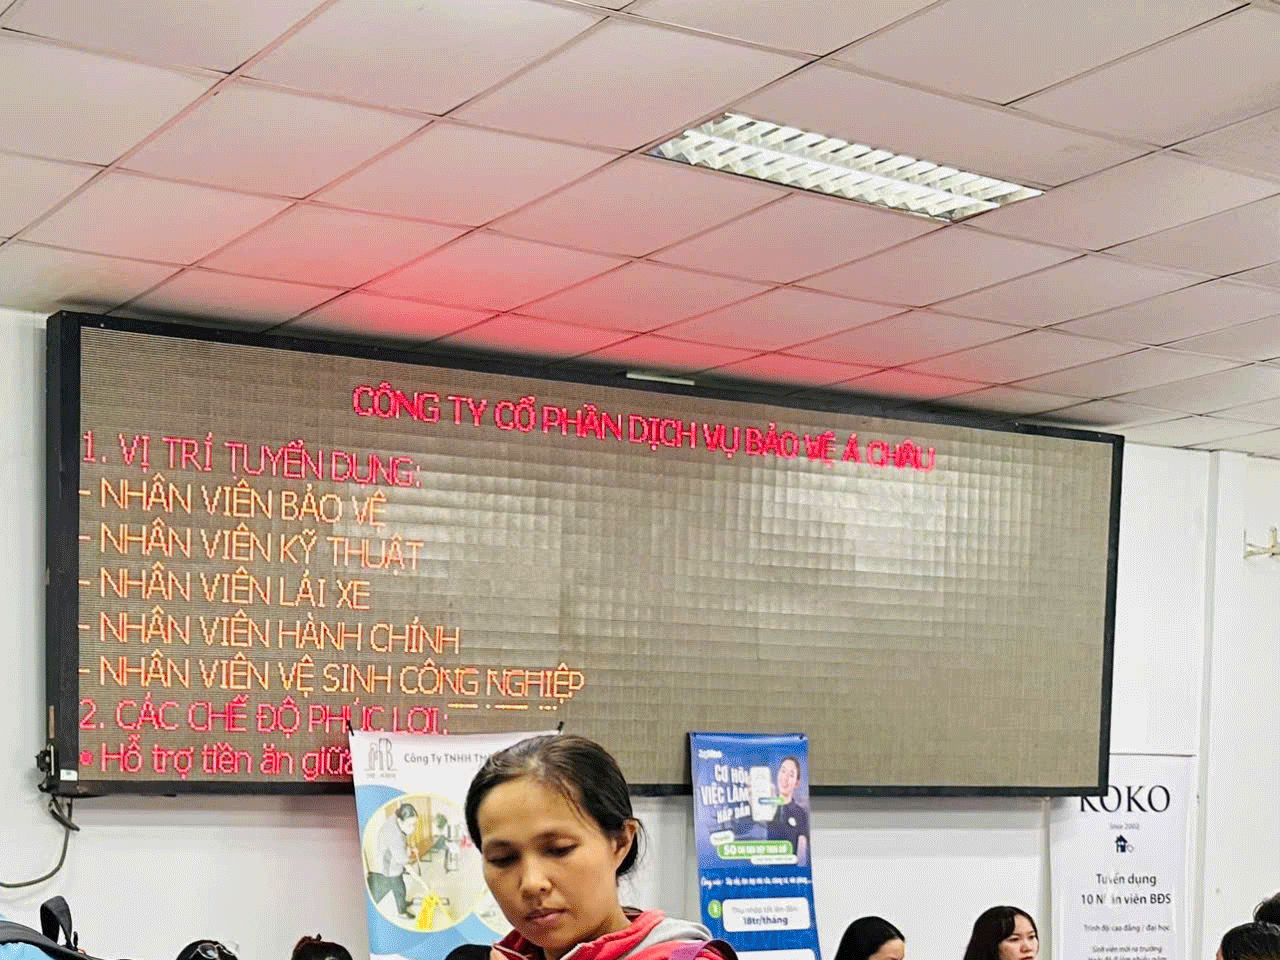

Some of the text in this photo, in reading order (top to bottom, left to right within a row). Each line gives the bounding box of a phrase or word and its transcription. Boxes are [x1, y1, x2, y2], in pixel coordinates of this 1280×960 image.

[352, 381, 937, 474] CÔNG TY CỔ PHẦN DỊCH VỤ BẢO VỆ Á CHÂU
[83, 431, 422, 489] 1. VỊ TRÍ TUYỂN DỤNG:
[100, 472, 192, 514] NHÂN
[200, 478, 273, 520] VIÊN
[280, 483, 343, 524] BẢO
[351, 487, 388, 533] VỆ
[100, 516, 192, 558] NHÂN
[200, 521, 272, 563] VIÊN
[279, 528, 318, 566] KỸ
[325, 531, 425, 577] THUẬT
[99, 560, 191, 602] NHÂN
[199, 565, 271, 606] VIÊN
[279, 568, 326, 608] LÁI
[335, 578, 371, 610] XE
[99, 604, 191, 645] NHÂN
[199, 608, 270, 649] VIÊN
[278, 611, 363, 651] HÀNH
[369, 617, 461, 655] CHÍNH
[99, 648, 191, 689] NHÂN
[199, 651, 270, 691] VIÊN
[278, 653, 315, 698] VỆ
[322, 662, 392, 694] SINH
[399, 657, 480, 696] CÔNG
[485, 661, 586, 705] NGHIỆP
[78, 697, 105, 730] 2.
[115, 692, 181, 731] CÁC
[187, 693, 249, 733] CHẾ
[256, 695, 301, 740] ĐỘ
[99, 733, 143, 774] Hỗ
[151, 744, 195, 780] trợ
[201, 741, 253, 776] tiền
[259, 742, 293, 776] ăn
[404, 752, 429, 766] Công
[431, 753, 442, 765] Ty
[444, 753, 472, 763] TNHH
[1081, 894, 1093, 905] 10
[1127, 873, 1157, 887] dụng
